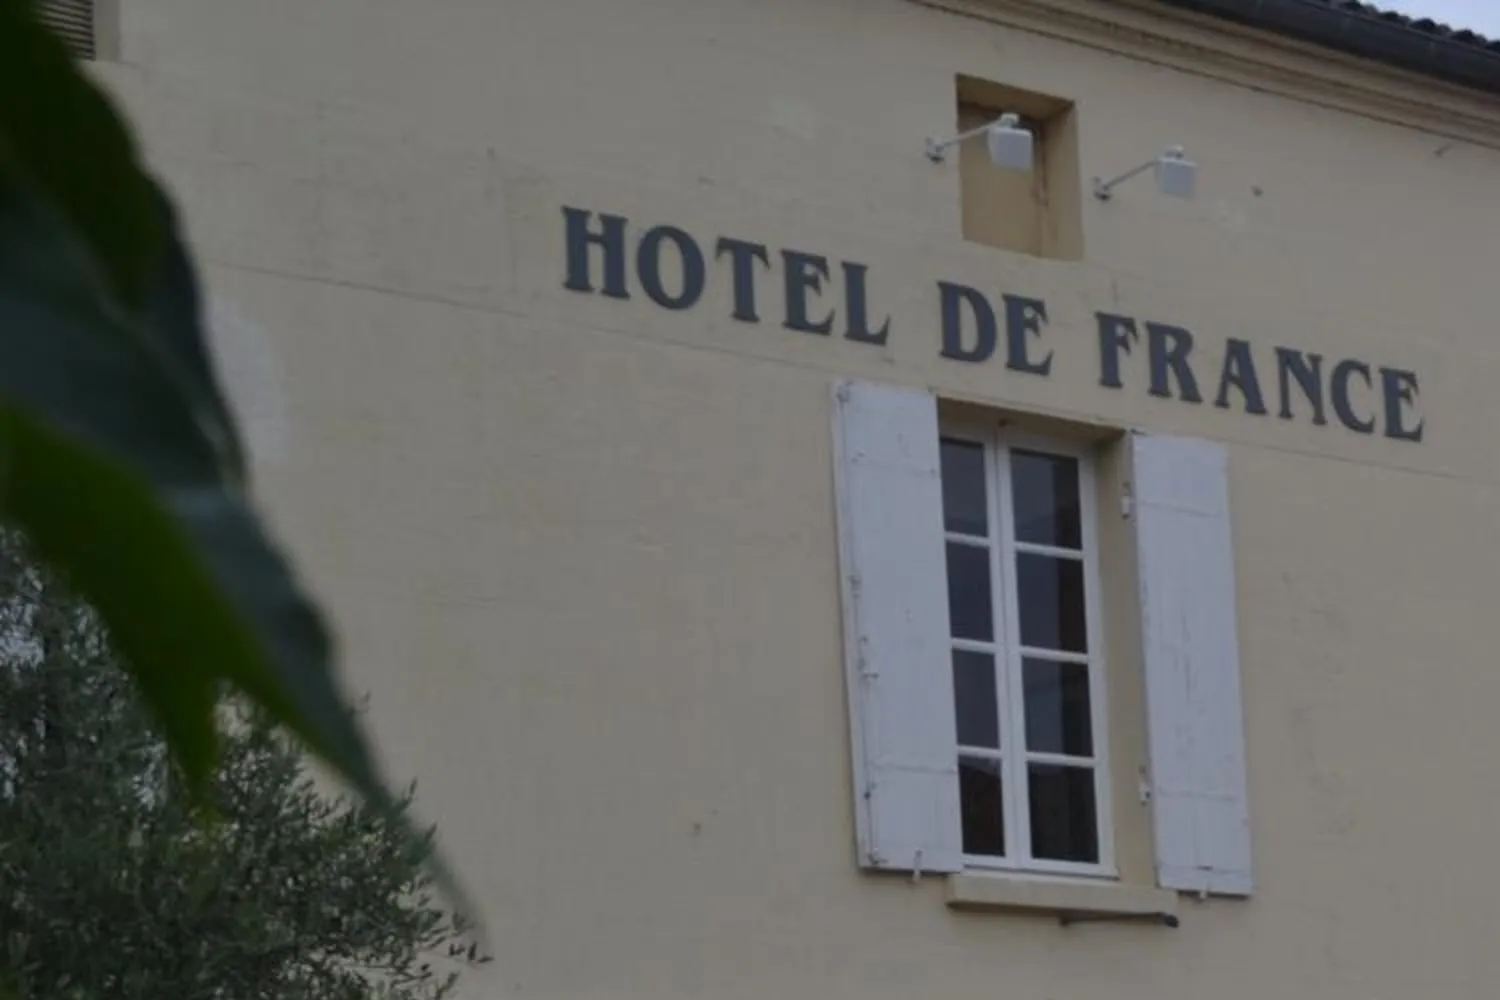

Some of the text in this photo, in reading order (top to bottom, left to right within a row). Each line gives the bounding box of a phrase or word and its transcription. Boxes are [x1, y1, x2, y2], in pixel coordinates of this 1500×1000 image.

[562, 205, 1424, 443] HOTEL DE FRANCE
